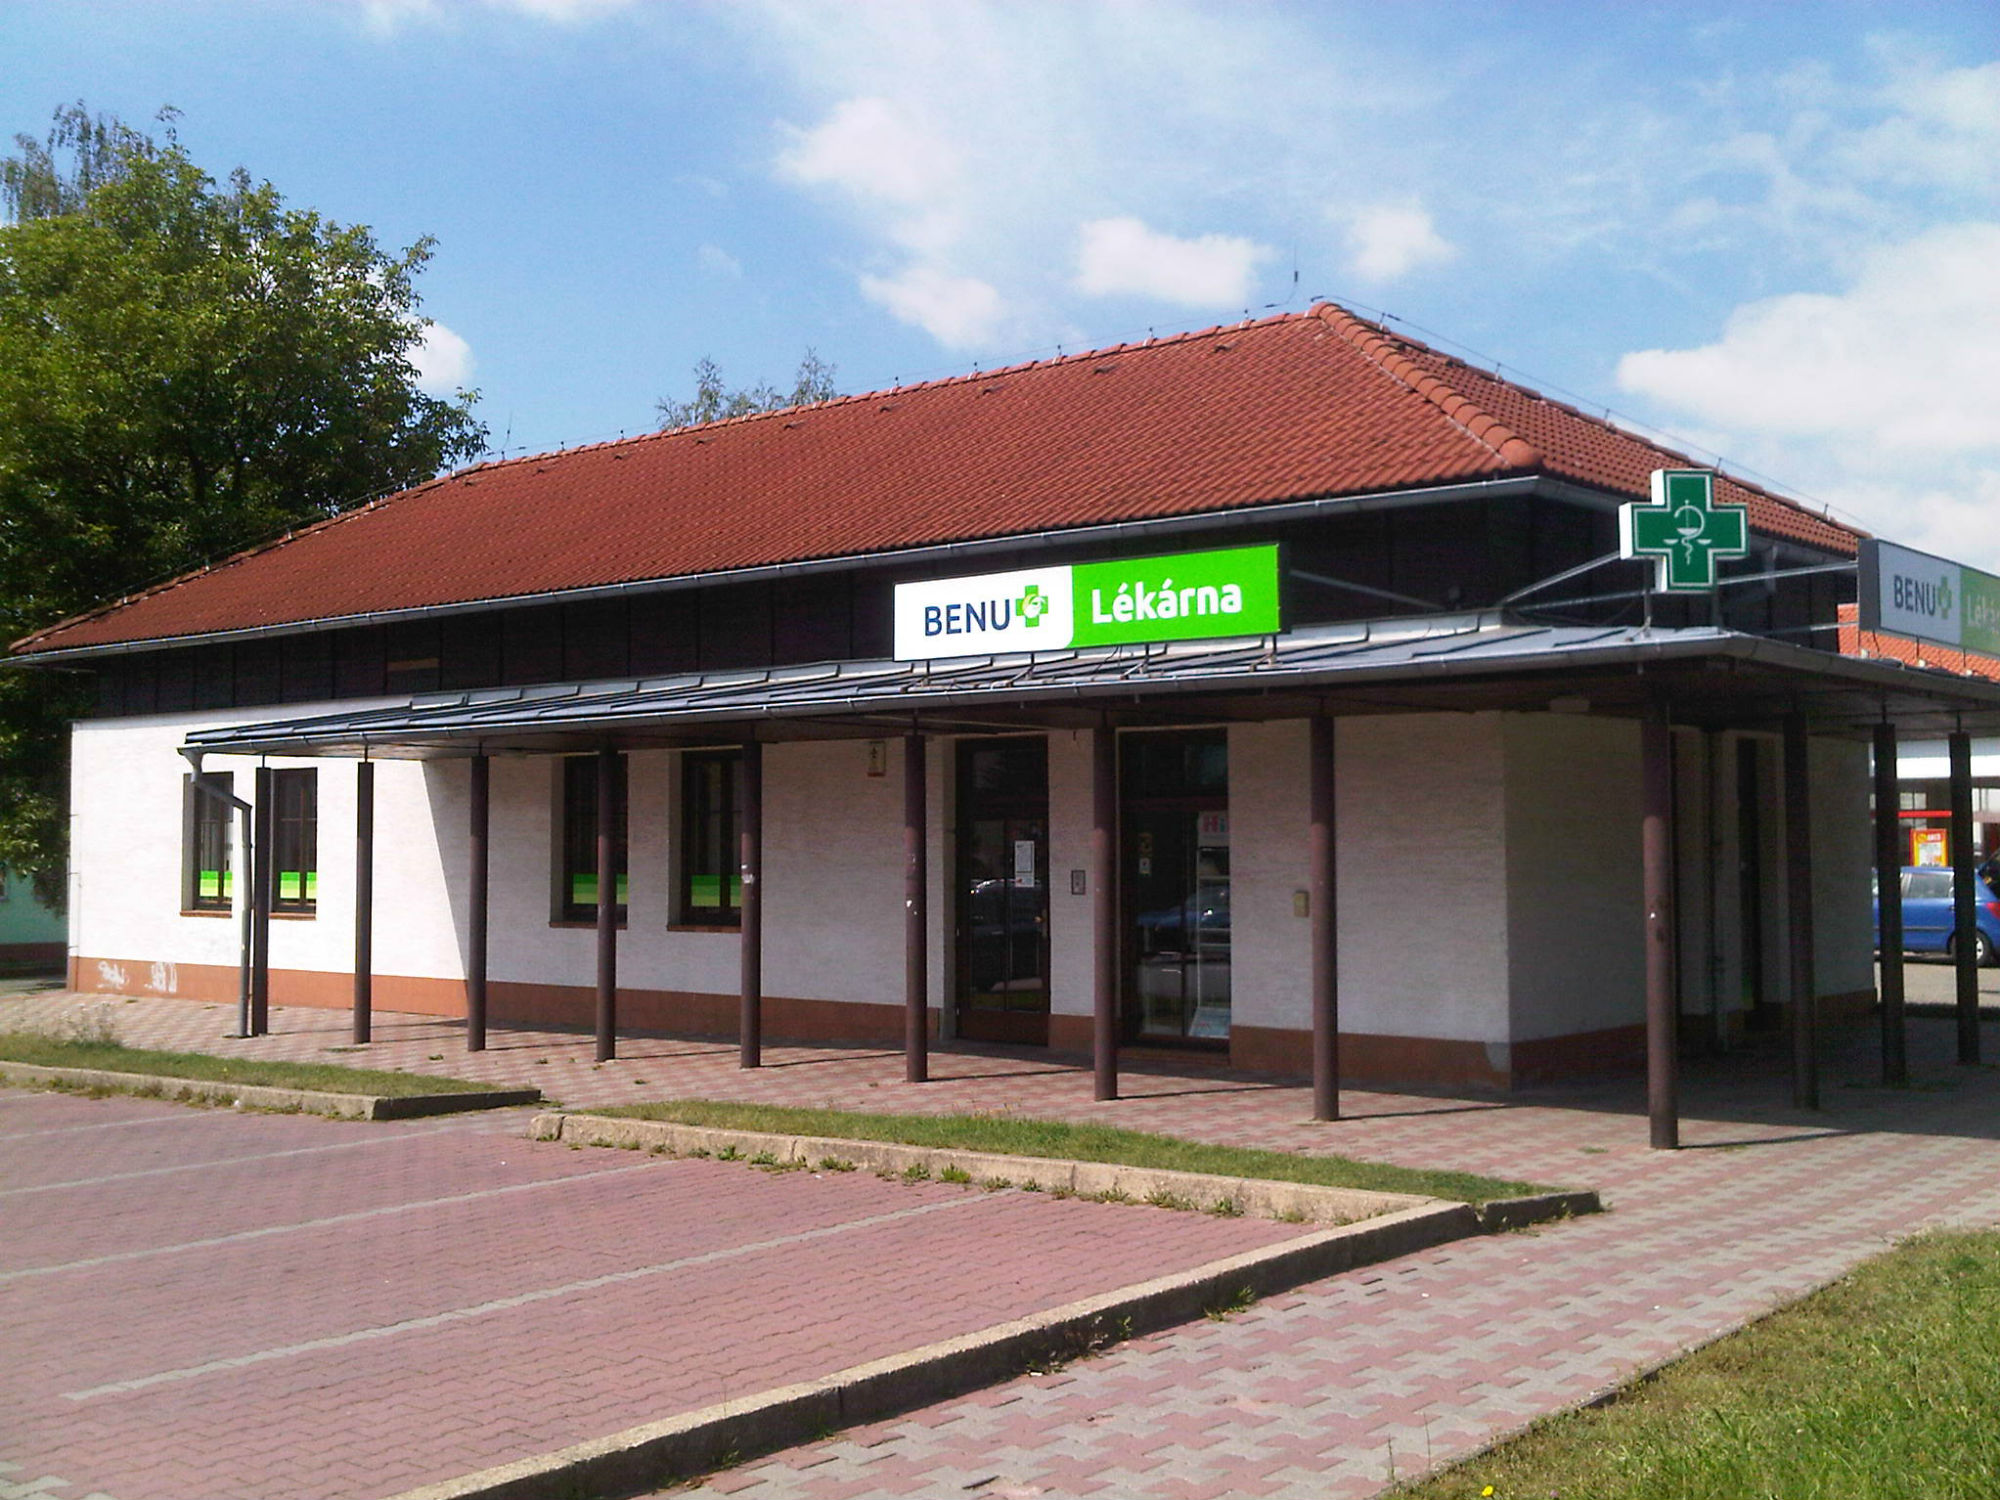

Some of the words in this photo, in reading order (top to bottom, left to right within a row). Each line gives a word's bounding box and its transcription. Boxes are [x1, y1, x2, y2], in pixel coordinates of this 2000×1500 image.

[924, 598, 1011, 637] BENU
[1091, 578, 1243, 624] Lékárna
[1894, 575, 1936, 616] BENU
